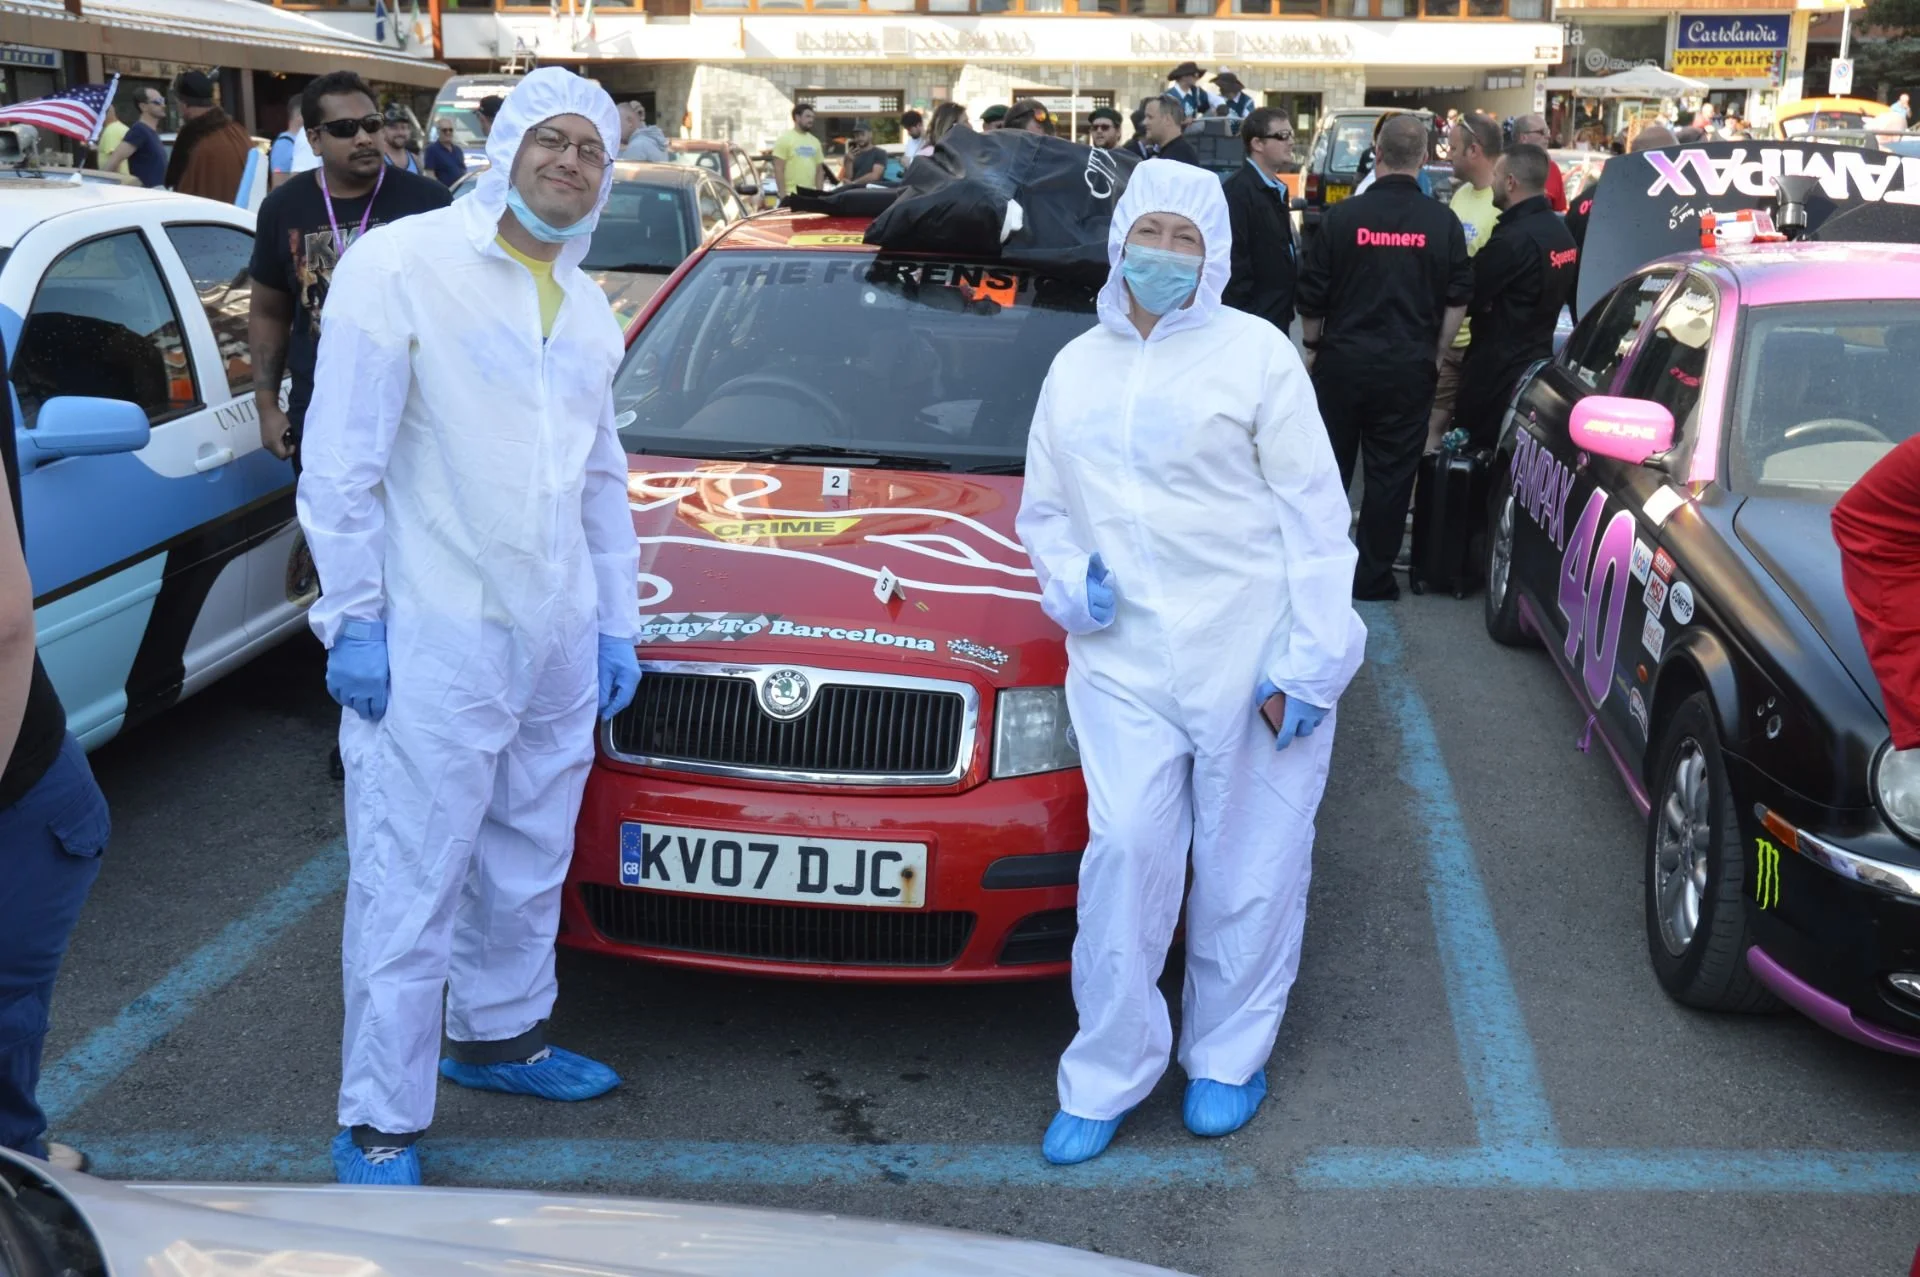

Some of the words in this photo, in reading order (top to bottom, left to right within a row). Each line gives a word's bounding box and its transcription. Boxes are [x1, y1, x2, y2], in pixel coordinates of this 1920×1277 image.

[1688, 20, 1779, 42] Cartolandia
[1677, 54, 1719, 66] VIDEO
[1643, 148, 1920, 205] TAMPAX
[1356, 227, 1426, 248] Dunners
[719, 261, 808, 288] THE
[831, 475, 841, 489] 2
[1510, 425, 1576, 553] TAMPAX
[713, 520, 836, 538] CRIME
[881, 577, 890, 591] 5
[1558, 486, 1636, 710] 40
[640, 619, 712, 637] rmy
[722, 619, 764, 635] To
[768, 620, 936, 652] Barcelona
[623, 861, 639, 876] GB
[640, 832, 779, 890] KV07
[796, 845, 903, 898] DJC
